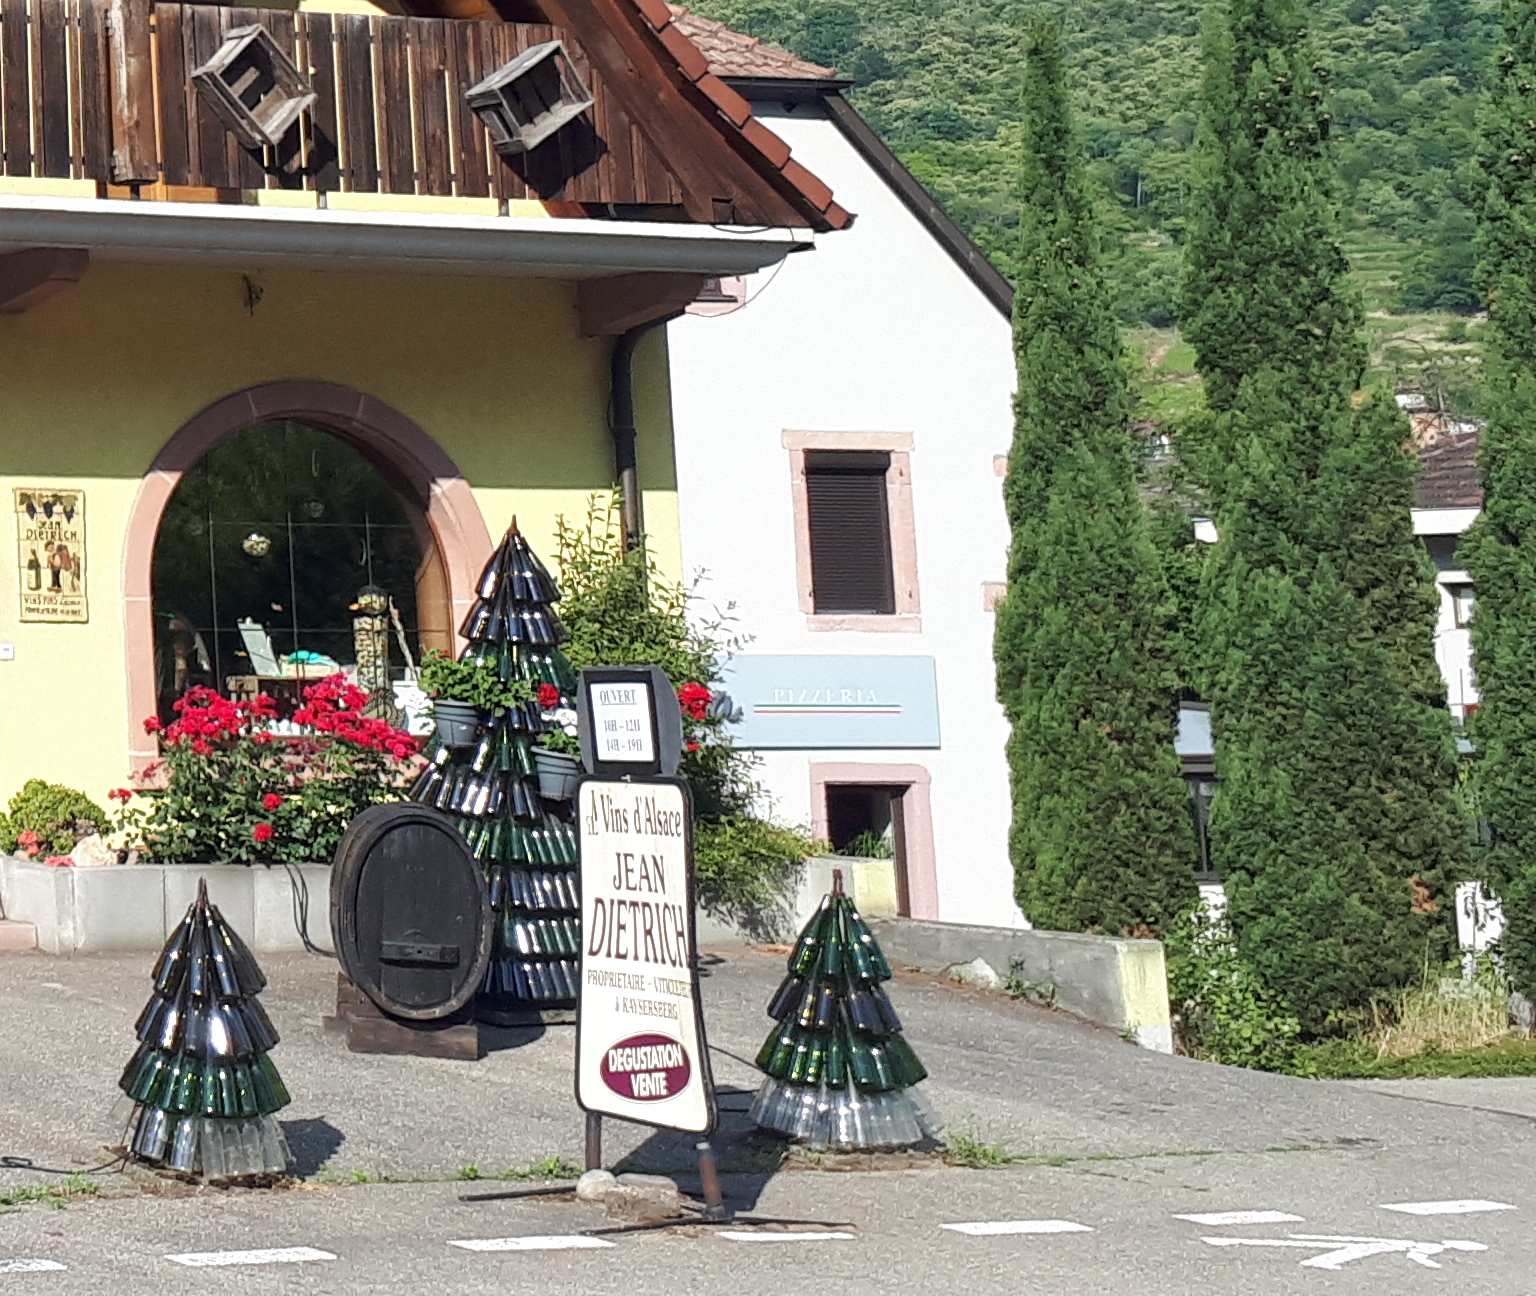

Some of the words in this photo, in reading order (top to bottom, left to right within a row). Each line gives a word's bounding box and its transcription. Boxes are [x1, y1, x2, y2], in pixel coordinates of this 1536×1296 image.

[599, 689, 637, 703] OUVERT
[773, 688, 878, 703] PIZZERIA
[600, 793, 628, 833] Vins
[633, 795, 682, 837] d'Alsace
[613, 852, 666, 895] JEAN
[587, 896, 689, 969] DIETRICH
[608, 1043, 684, 1073] DEGUSTATION
[630, 1071, 668, 1097] VENTE
